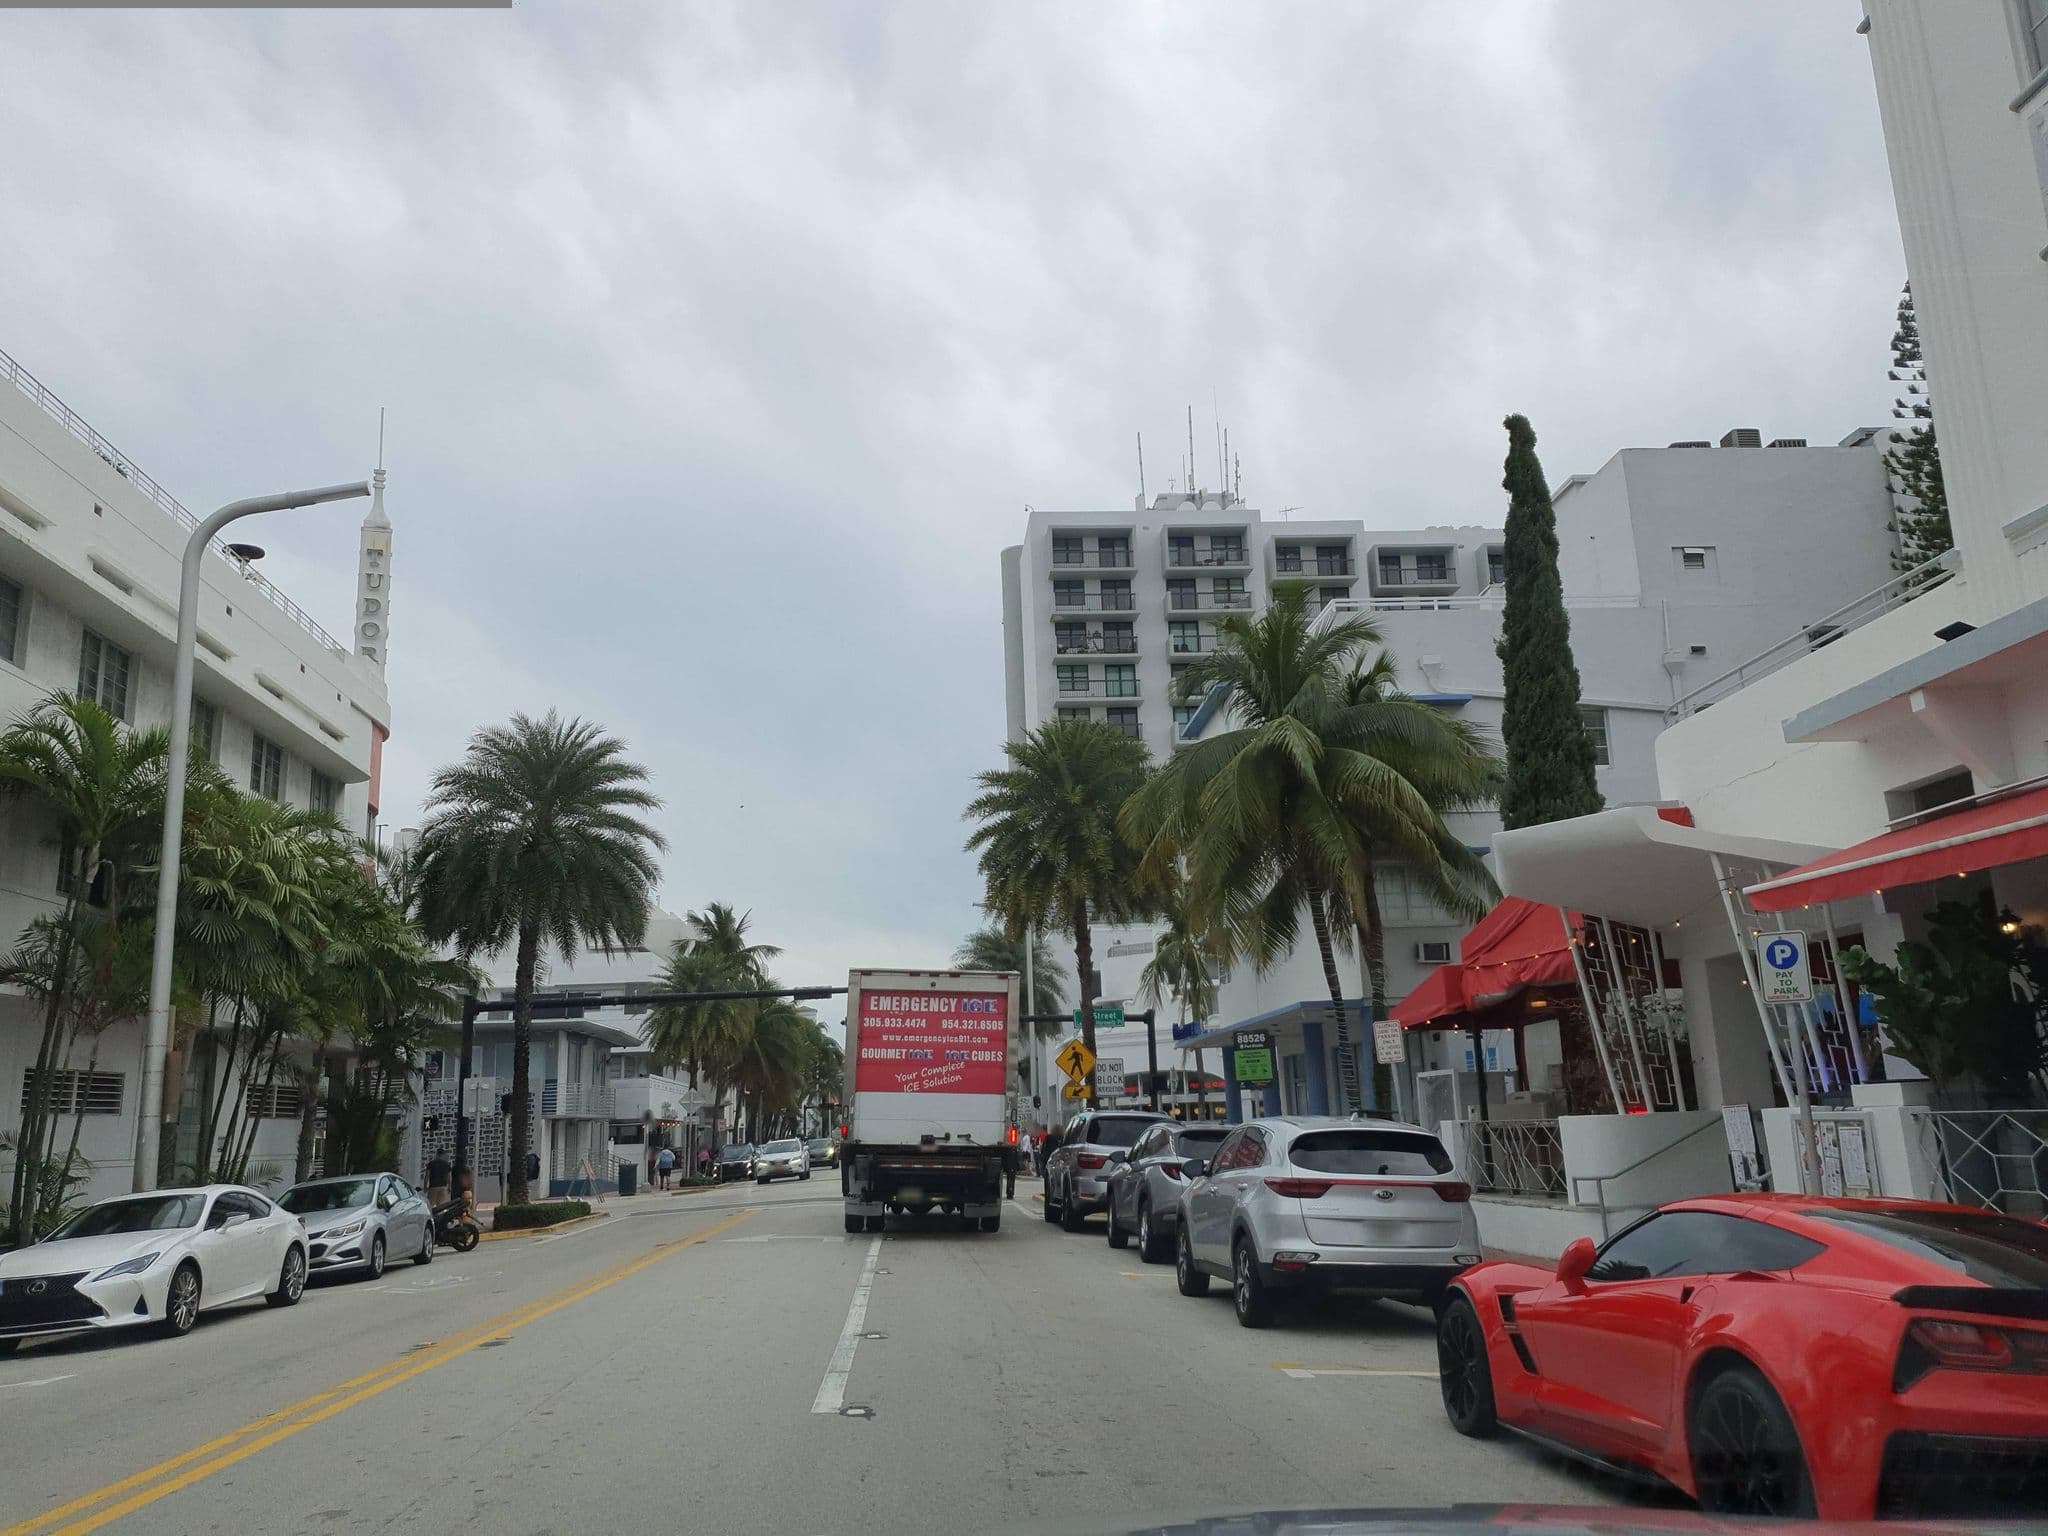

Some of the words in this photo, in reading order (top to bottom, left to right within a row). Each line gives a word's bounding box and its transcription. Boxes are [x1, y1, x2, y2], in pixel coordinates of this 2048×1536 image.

[361, 548, 384, 665] TUDOR
[1780, 979, 1792, 987] TO
[1774, 986, 1799, 994] PARK
[870, 996, 958, 1012] EMERGENCY
[961, 997, 998, 1014] ICE
[1093, 1012, 1116, 1020] Street
[863, 1017, 926, 1028] 305.933.4474
[942, 1018, 1004, 1030] 954.321.6505
[882, 1034, 988, 1044] www.emergencyice911.com
[861, 1047, 907, 1059] GOURMET
[971, 1050, 1003, 1061] CUBES
[895, 1070, 918, 1083] Your
[921, 1060, 966, 1077] Complete
[1096, 1063, 1107, 1072] DO
[1109, 1063, 1122, 1072] NOT
[903, 1081, 920, 1093] ICE
[923, 1074, 962, 1089] Solution
[1097, 1075, 1123, 1084] BLOCK
